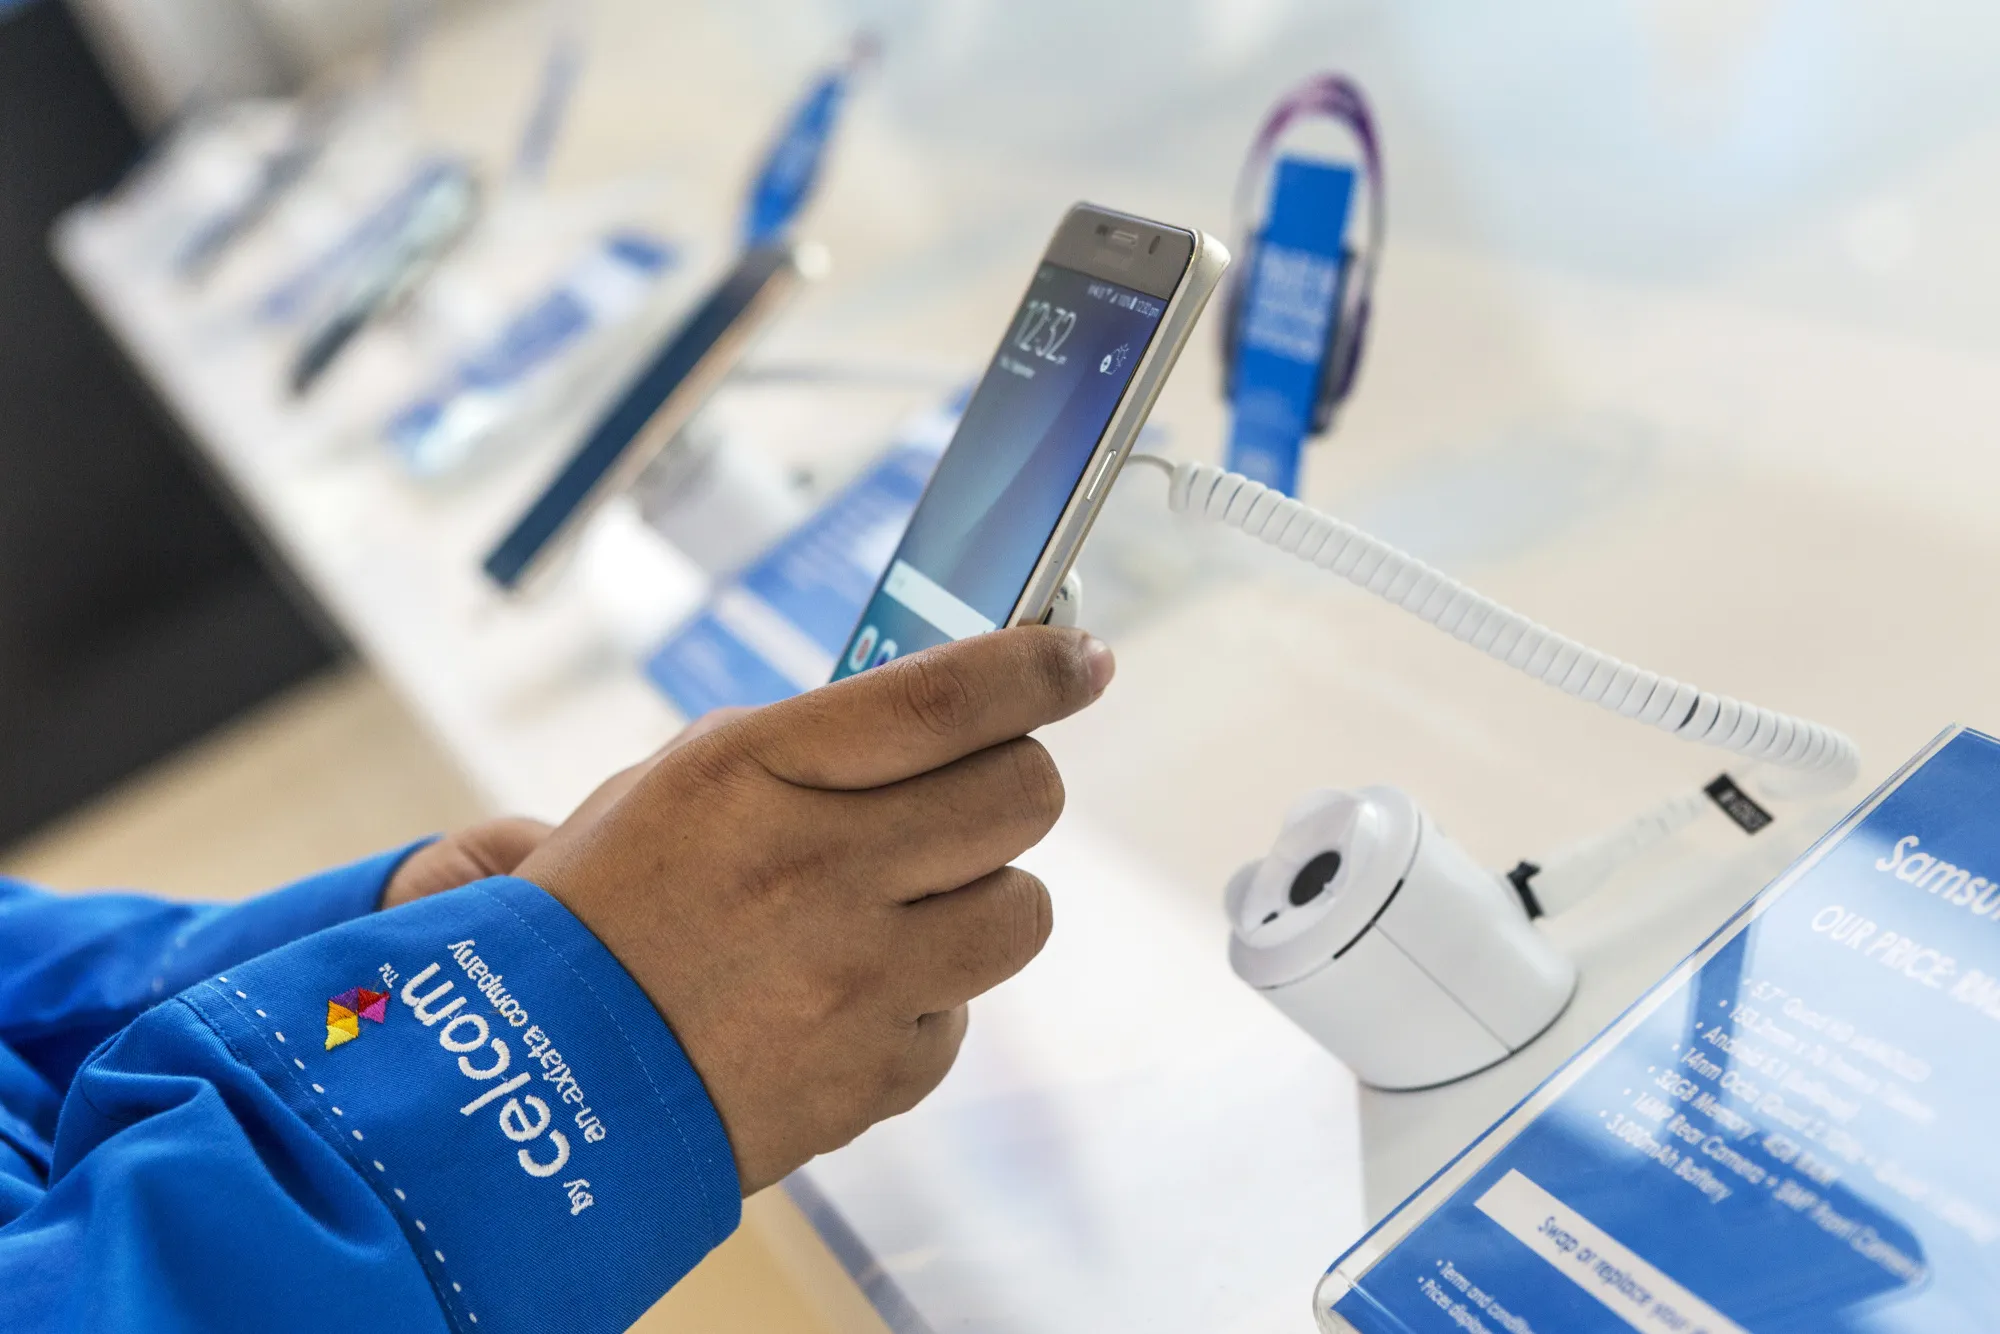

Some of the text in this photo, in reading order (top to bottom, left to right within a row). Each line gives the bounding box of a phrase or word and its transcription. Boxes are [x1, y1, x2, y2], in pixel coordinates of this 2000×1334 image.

[1012, 300, 1076, 362] 12:32
[1875, 835, 2000, 920] Samsu
[1811, 905, 1878, 950] OUR
[446, 941, 529, 1025] company
[400, 961, 570, 1180] celcom
[1682, 1051, 1723, 1080] 14nm
[1656, 1071, 1698, 1101] 32GB
[1694, 1092, 1758, 1140] Memory
[1668, 1115, 1704, 1144] Rear
[1704, 1137, 1767, 1184] Camera
[1675, 1157, 1733, 1203] Battery
[560, 1180, 595, 1215] by
[1439, 1261, 1471, 1292] Terms
[1466, 1285, 1494, 1309] and
[1537, 1215, 1580, 1254] Swap
[1575, 1246, 1598, 1266] or
[1593, 1260, 1652, 1306] replace
[1419, 1278, 1453, 1310] Prices
